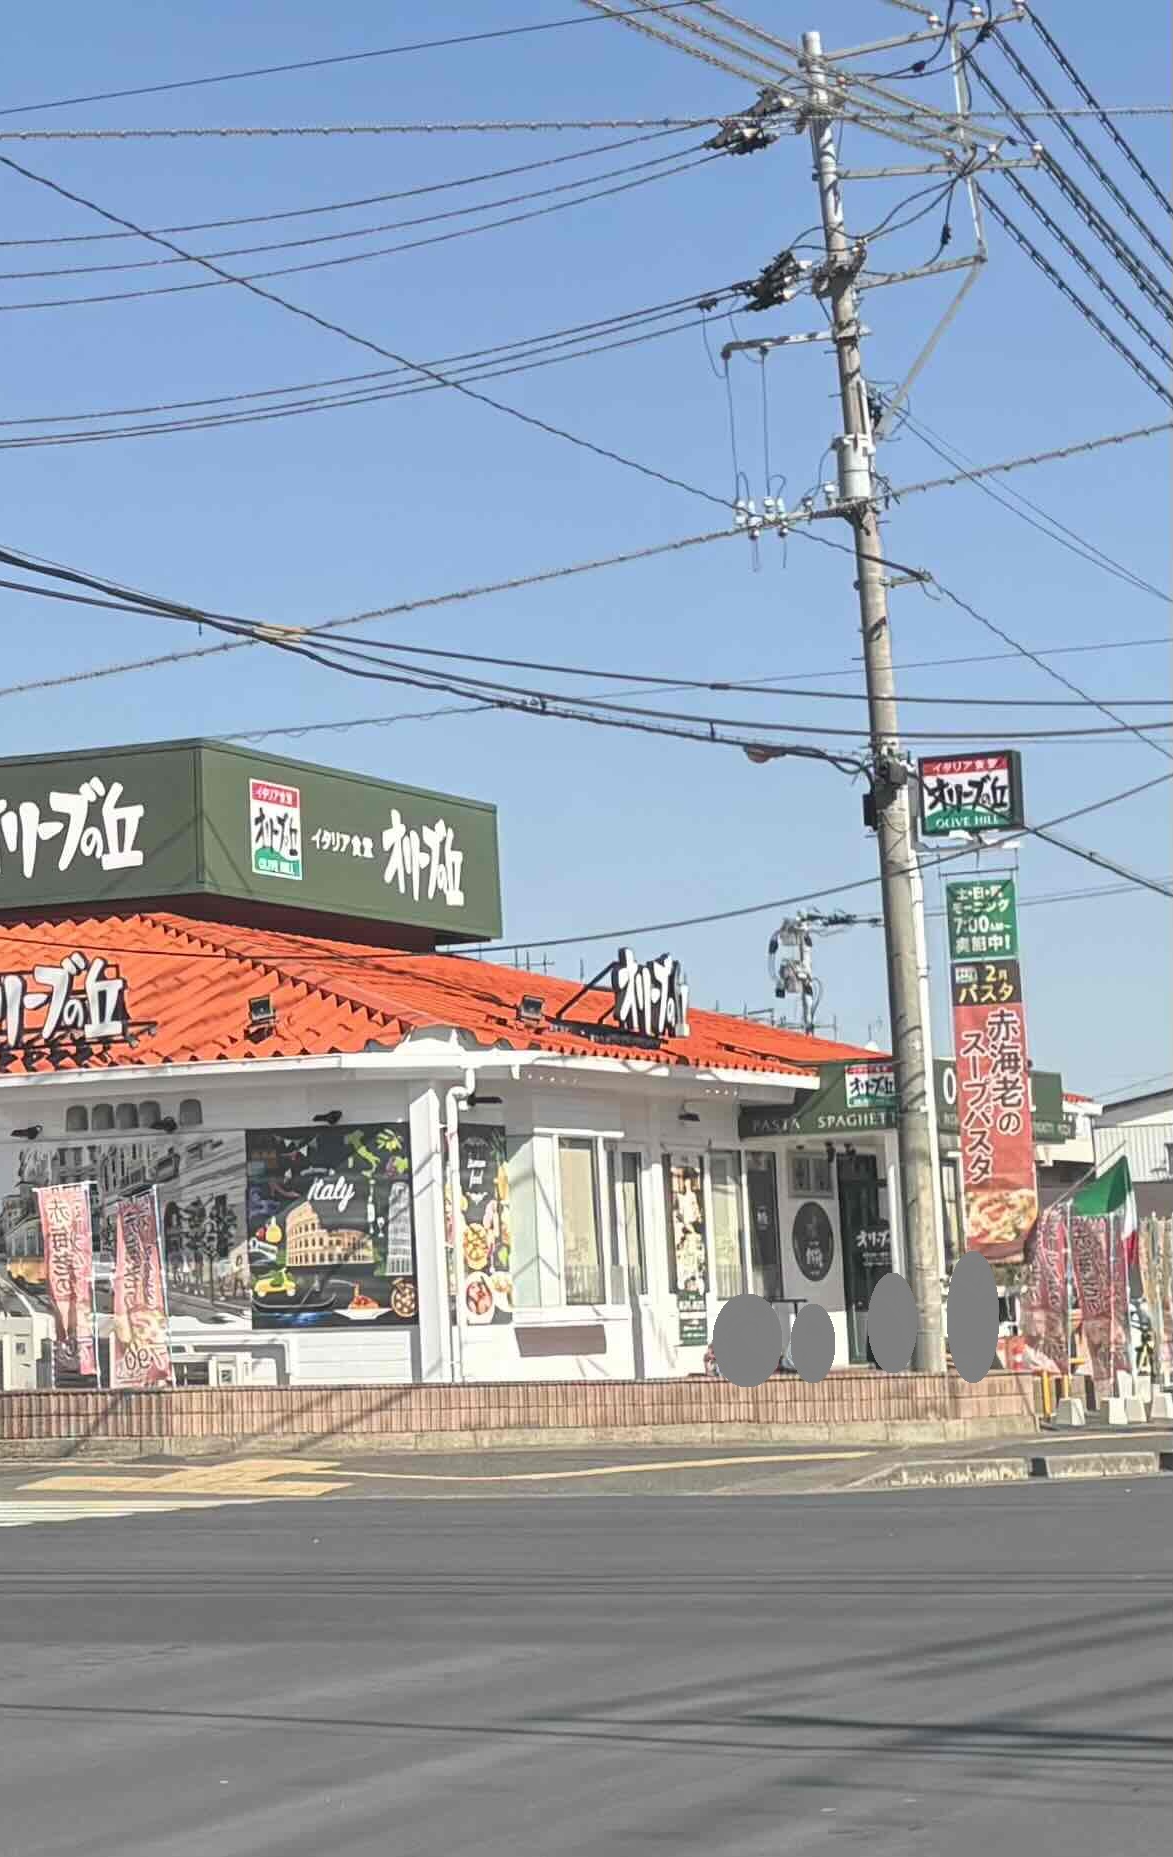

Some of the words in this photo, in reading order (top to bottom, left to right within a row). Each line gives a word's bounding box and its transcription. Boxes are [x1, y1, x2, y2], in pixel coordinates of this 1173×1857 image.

[927, 775, 1009, 812] オリーブの丘
[254, 807, 298, 857] オリーブの丘
[936, 816, 971, 829] OLIVE
[974, 814, 999, 825] HILL
[311, 827, 374, 859] イタリア食堂
[382, 809, 465, 907] オリーブの丘
[953, 899, 1010, 914] モーニング
[985, 964, 1008, 982] 2月
[618, 948, 690, 1037] オリーブの丘
[959, 983, 1014, 1003] パスタ
[988, 1008, 1024, 1134] 赤海老の
[962, 1031, 993, 1183] スープパスタ
